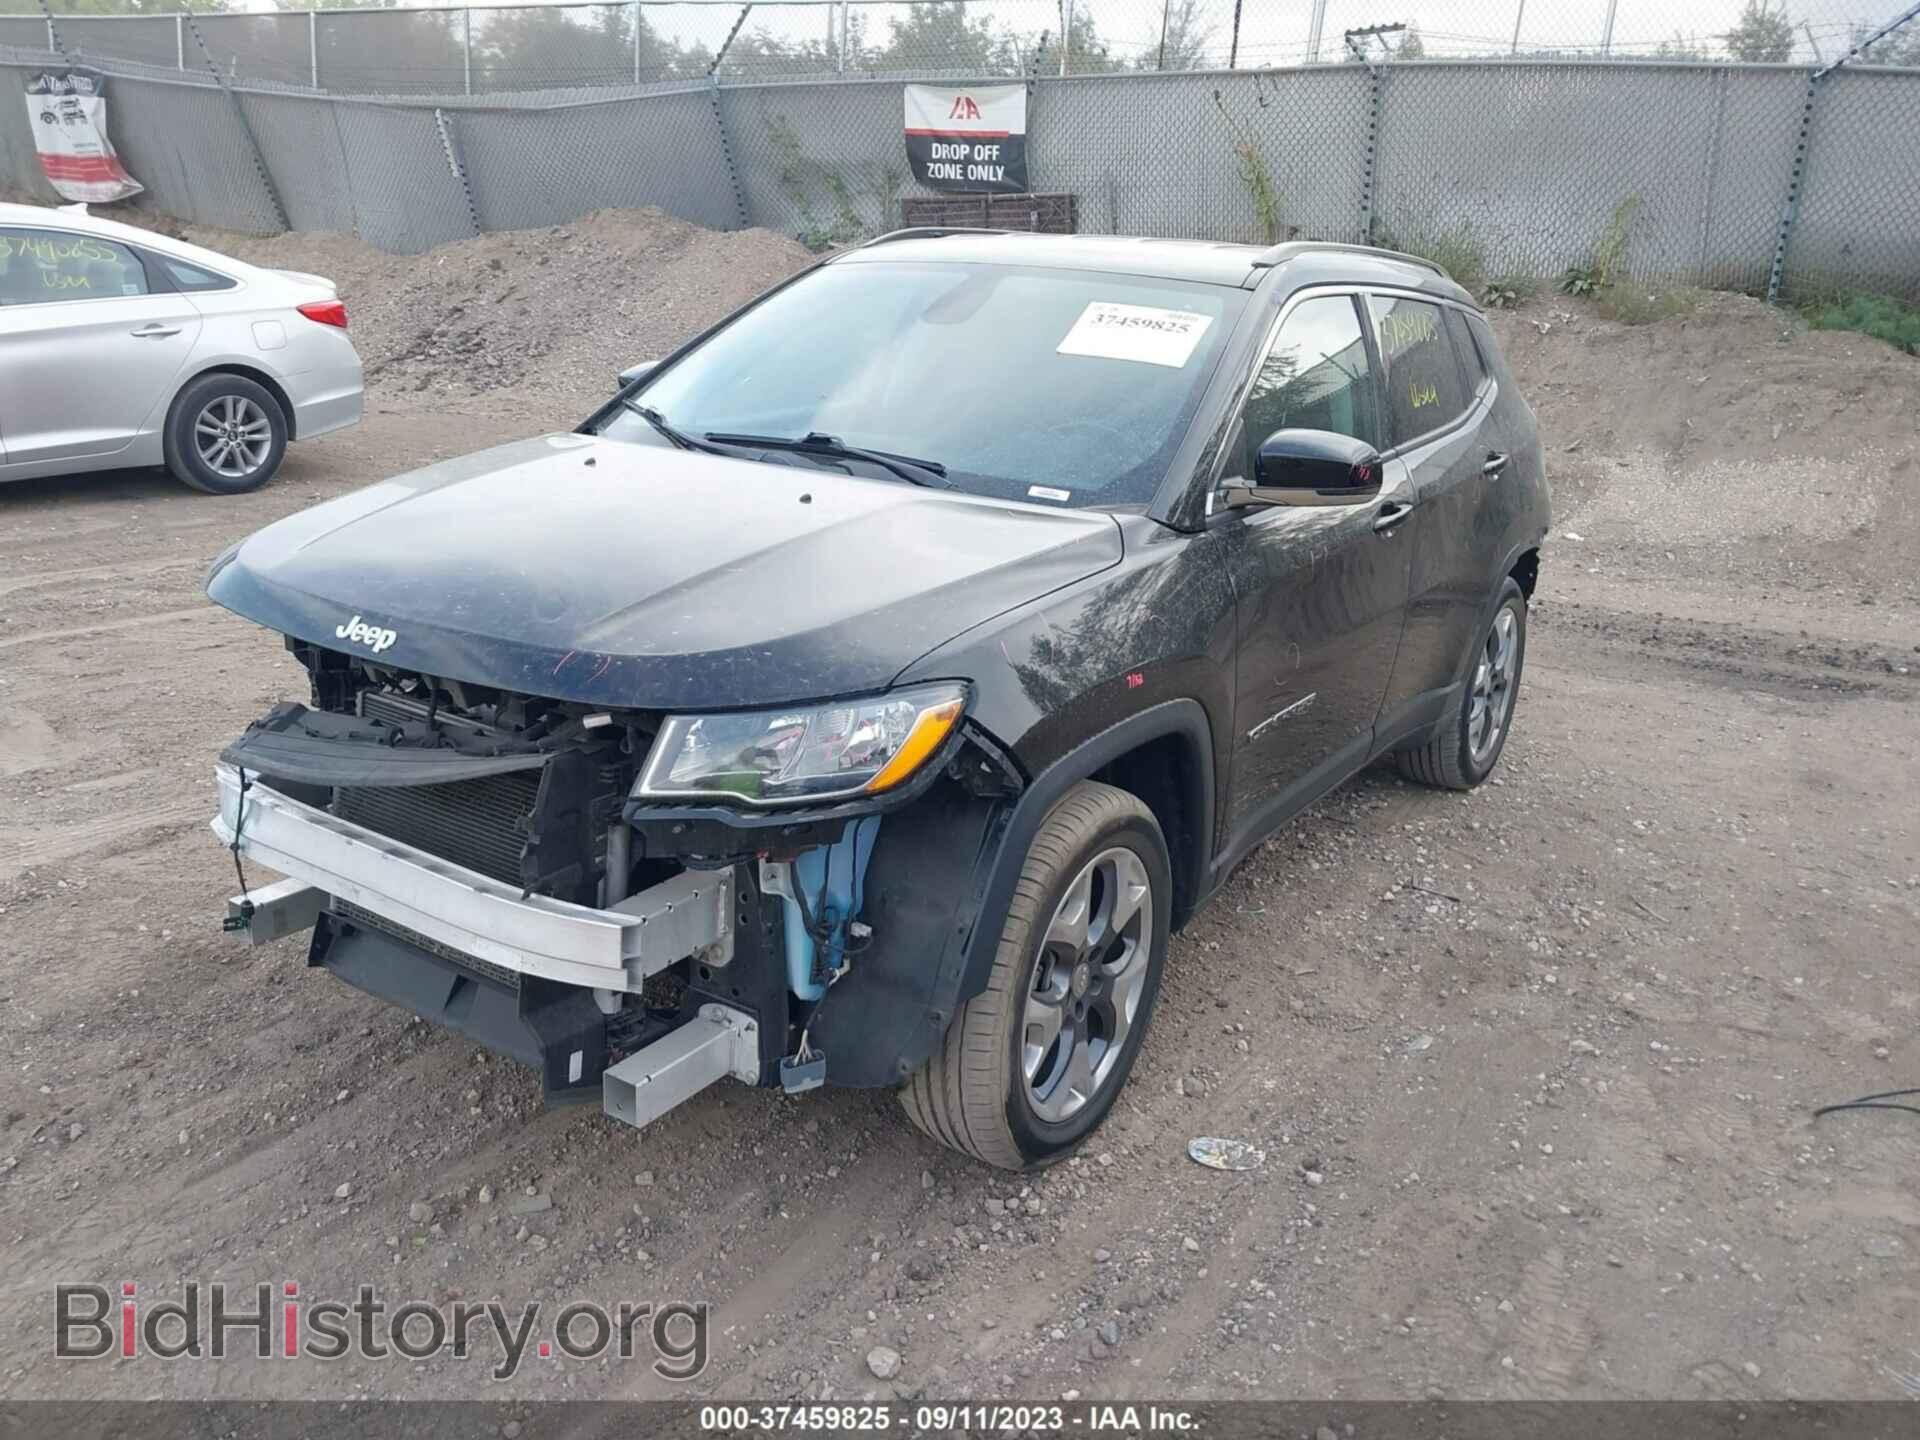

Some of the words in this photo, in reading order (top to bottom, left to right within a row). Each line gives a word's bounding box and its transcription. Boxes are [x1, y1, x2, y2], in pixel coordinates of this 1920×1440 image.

[931, 142, 970, 160] DROP
[974, 145, 1000, 160] OFF
[926, 162, 964, 179] ZONE
[967, 164, 1005, 181] ONLY
[1090, 313, 1191, 334] 37459825
[335, 615, 397, 653] Jeep
